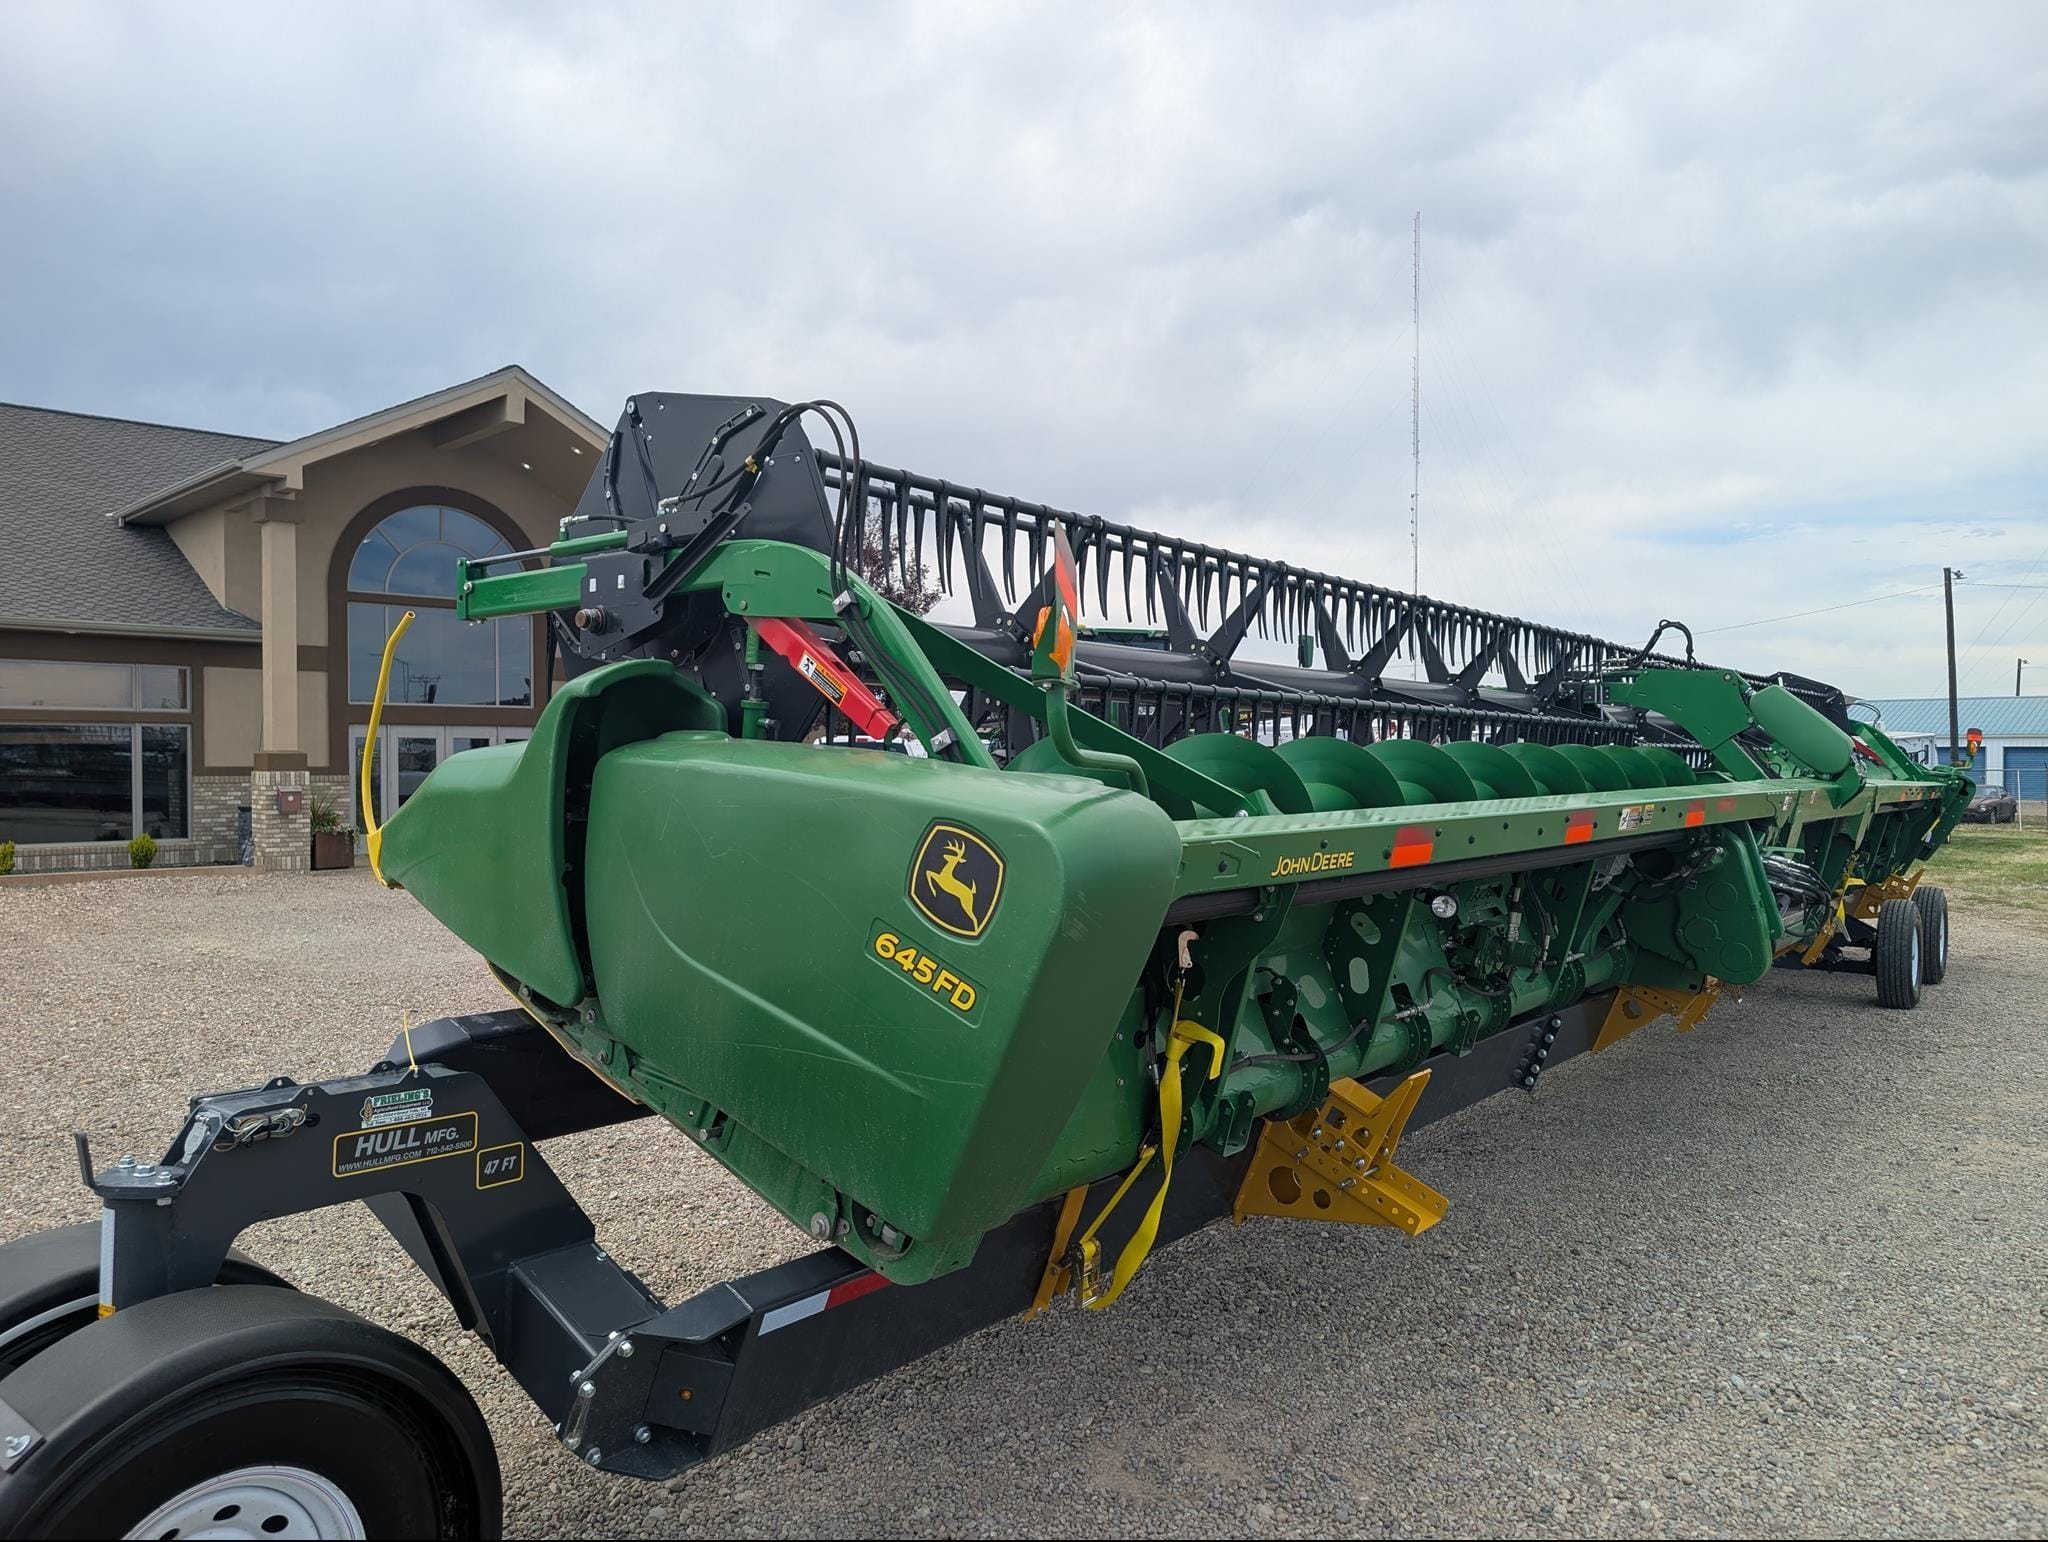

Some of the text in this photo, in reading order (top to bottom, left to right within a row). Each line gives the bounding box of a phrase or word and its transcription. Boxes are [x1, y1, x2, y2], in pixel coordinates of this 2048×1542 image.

[1271, 851, 1355, 877] JOHN DEERE
[875, 932, 977, 1011] 645FD
[338, 1140, 473, 1173] WWW.HULLMFG.COM 712-542-5500
[354, 1127, 459, 1158] HULL MFG.
[484, 1156, 517, 1175] 47 FT
